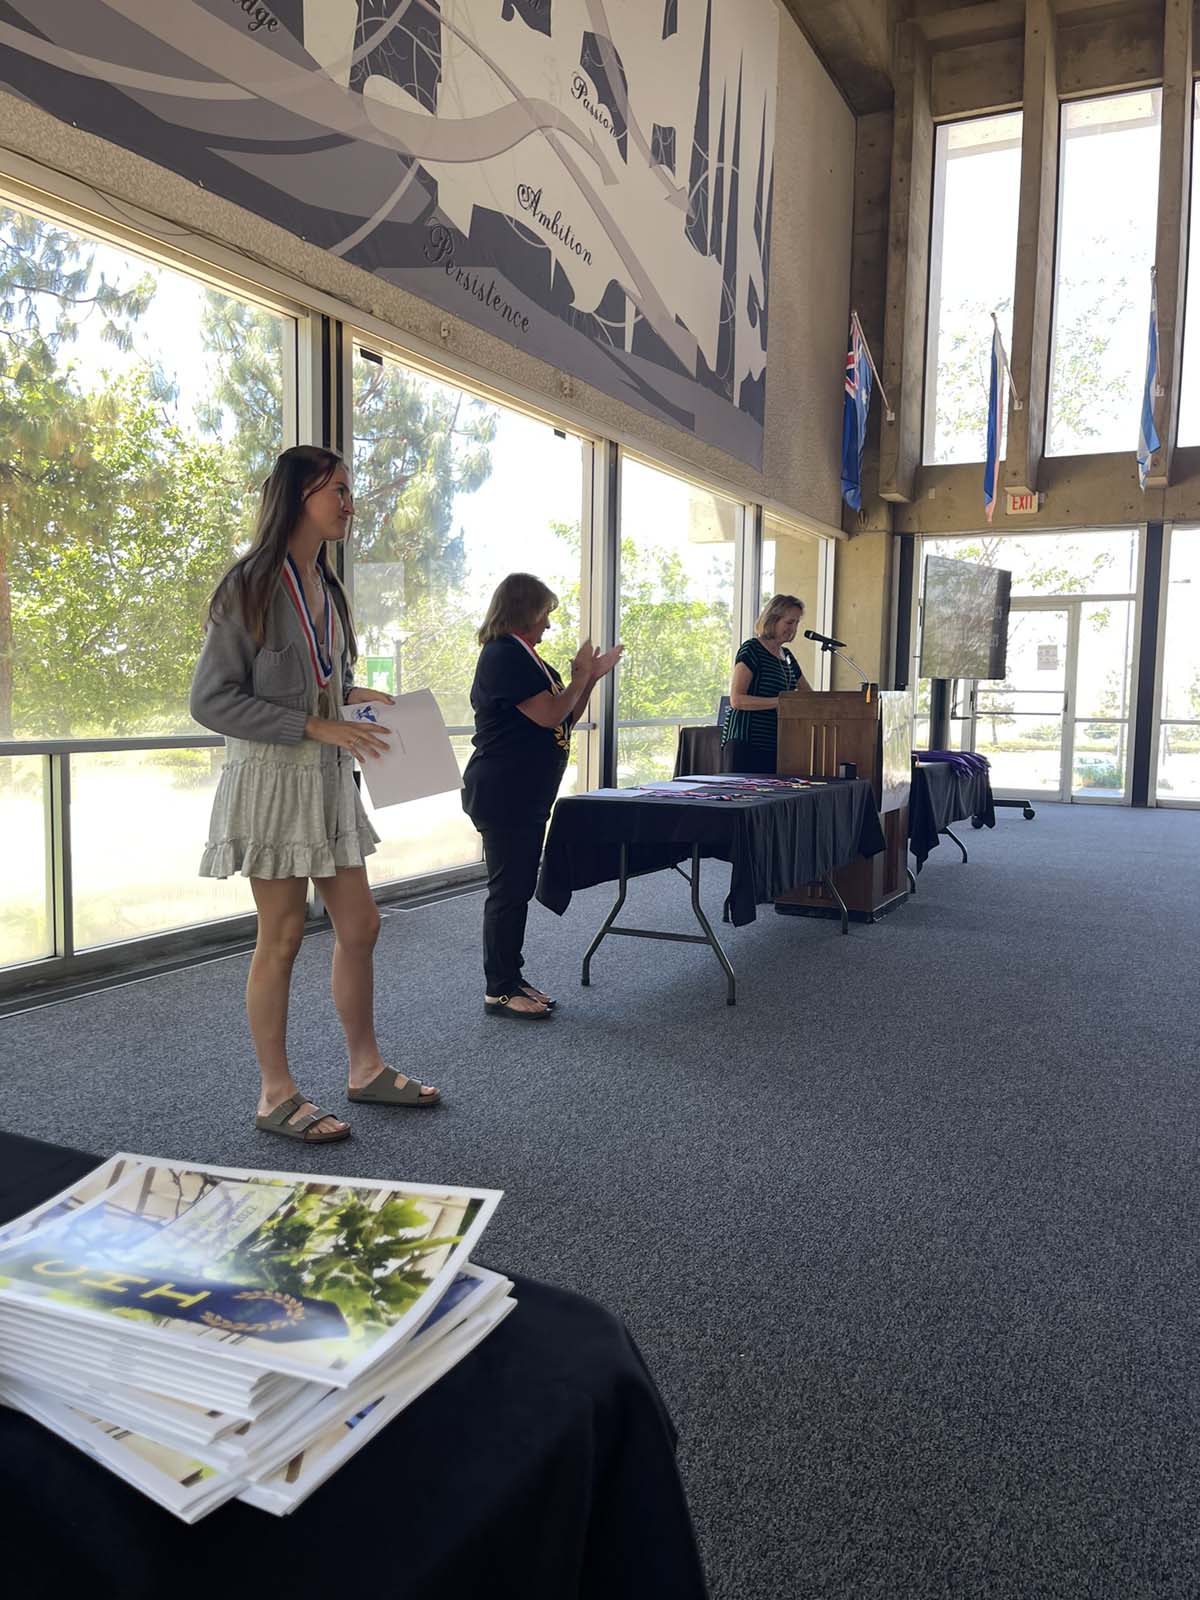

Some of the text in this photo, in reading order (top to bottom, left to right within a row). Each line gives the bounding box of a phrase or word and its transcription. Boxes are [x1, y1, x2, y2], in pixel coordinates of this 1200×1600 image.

[570, 73, 618, 138] Passion
[517, 183, 593, 266] Ambition
[424, 219, 531, 333] Persistence
[1011, 494, 1033, 512] EXIT
